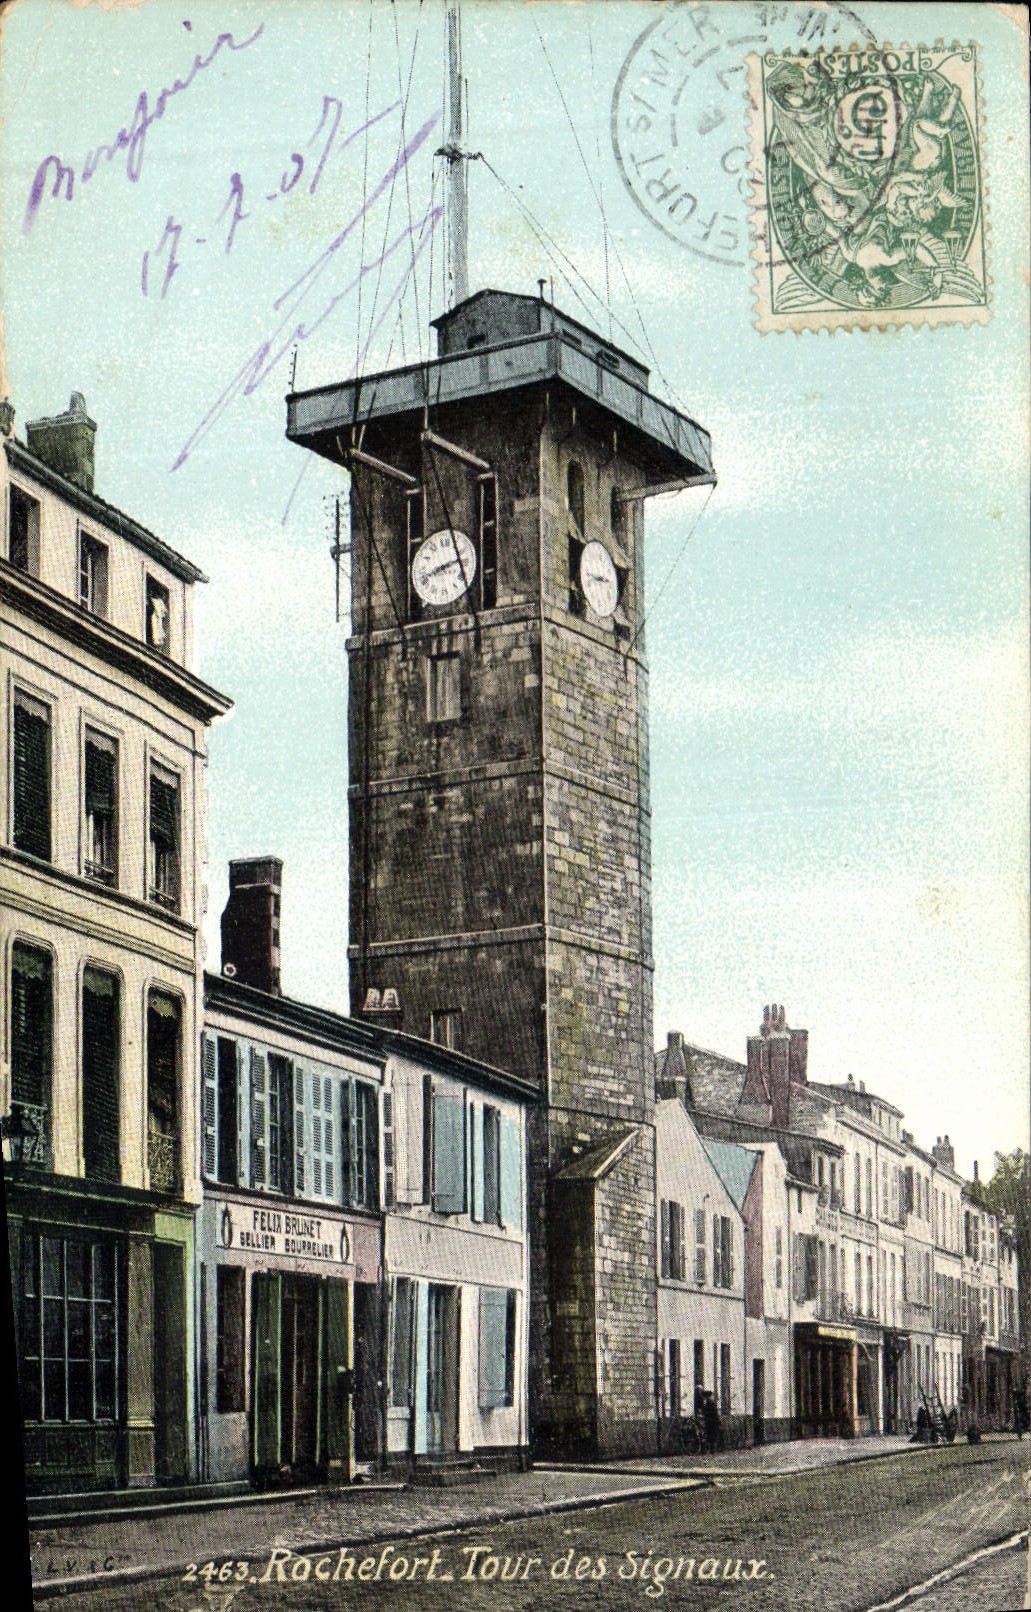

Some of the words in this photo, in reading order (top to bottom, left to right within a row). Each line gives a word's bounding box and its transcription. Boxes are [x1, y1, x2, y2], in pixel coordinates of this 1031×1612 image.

[823, 51, 916, 76] POSTES
[253, 1210, 282, 1233] FELIX
[285, 1215, 322, 1239] BRUNET
[285, 1238, 334, 1257] BOURRELIER
